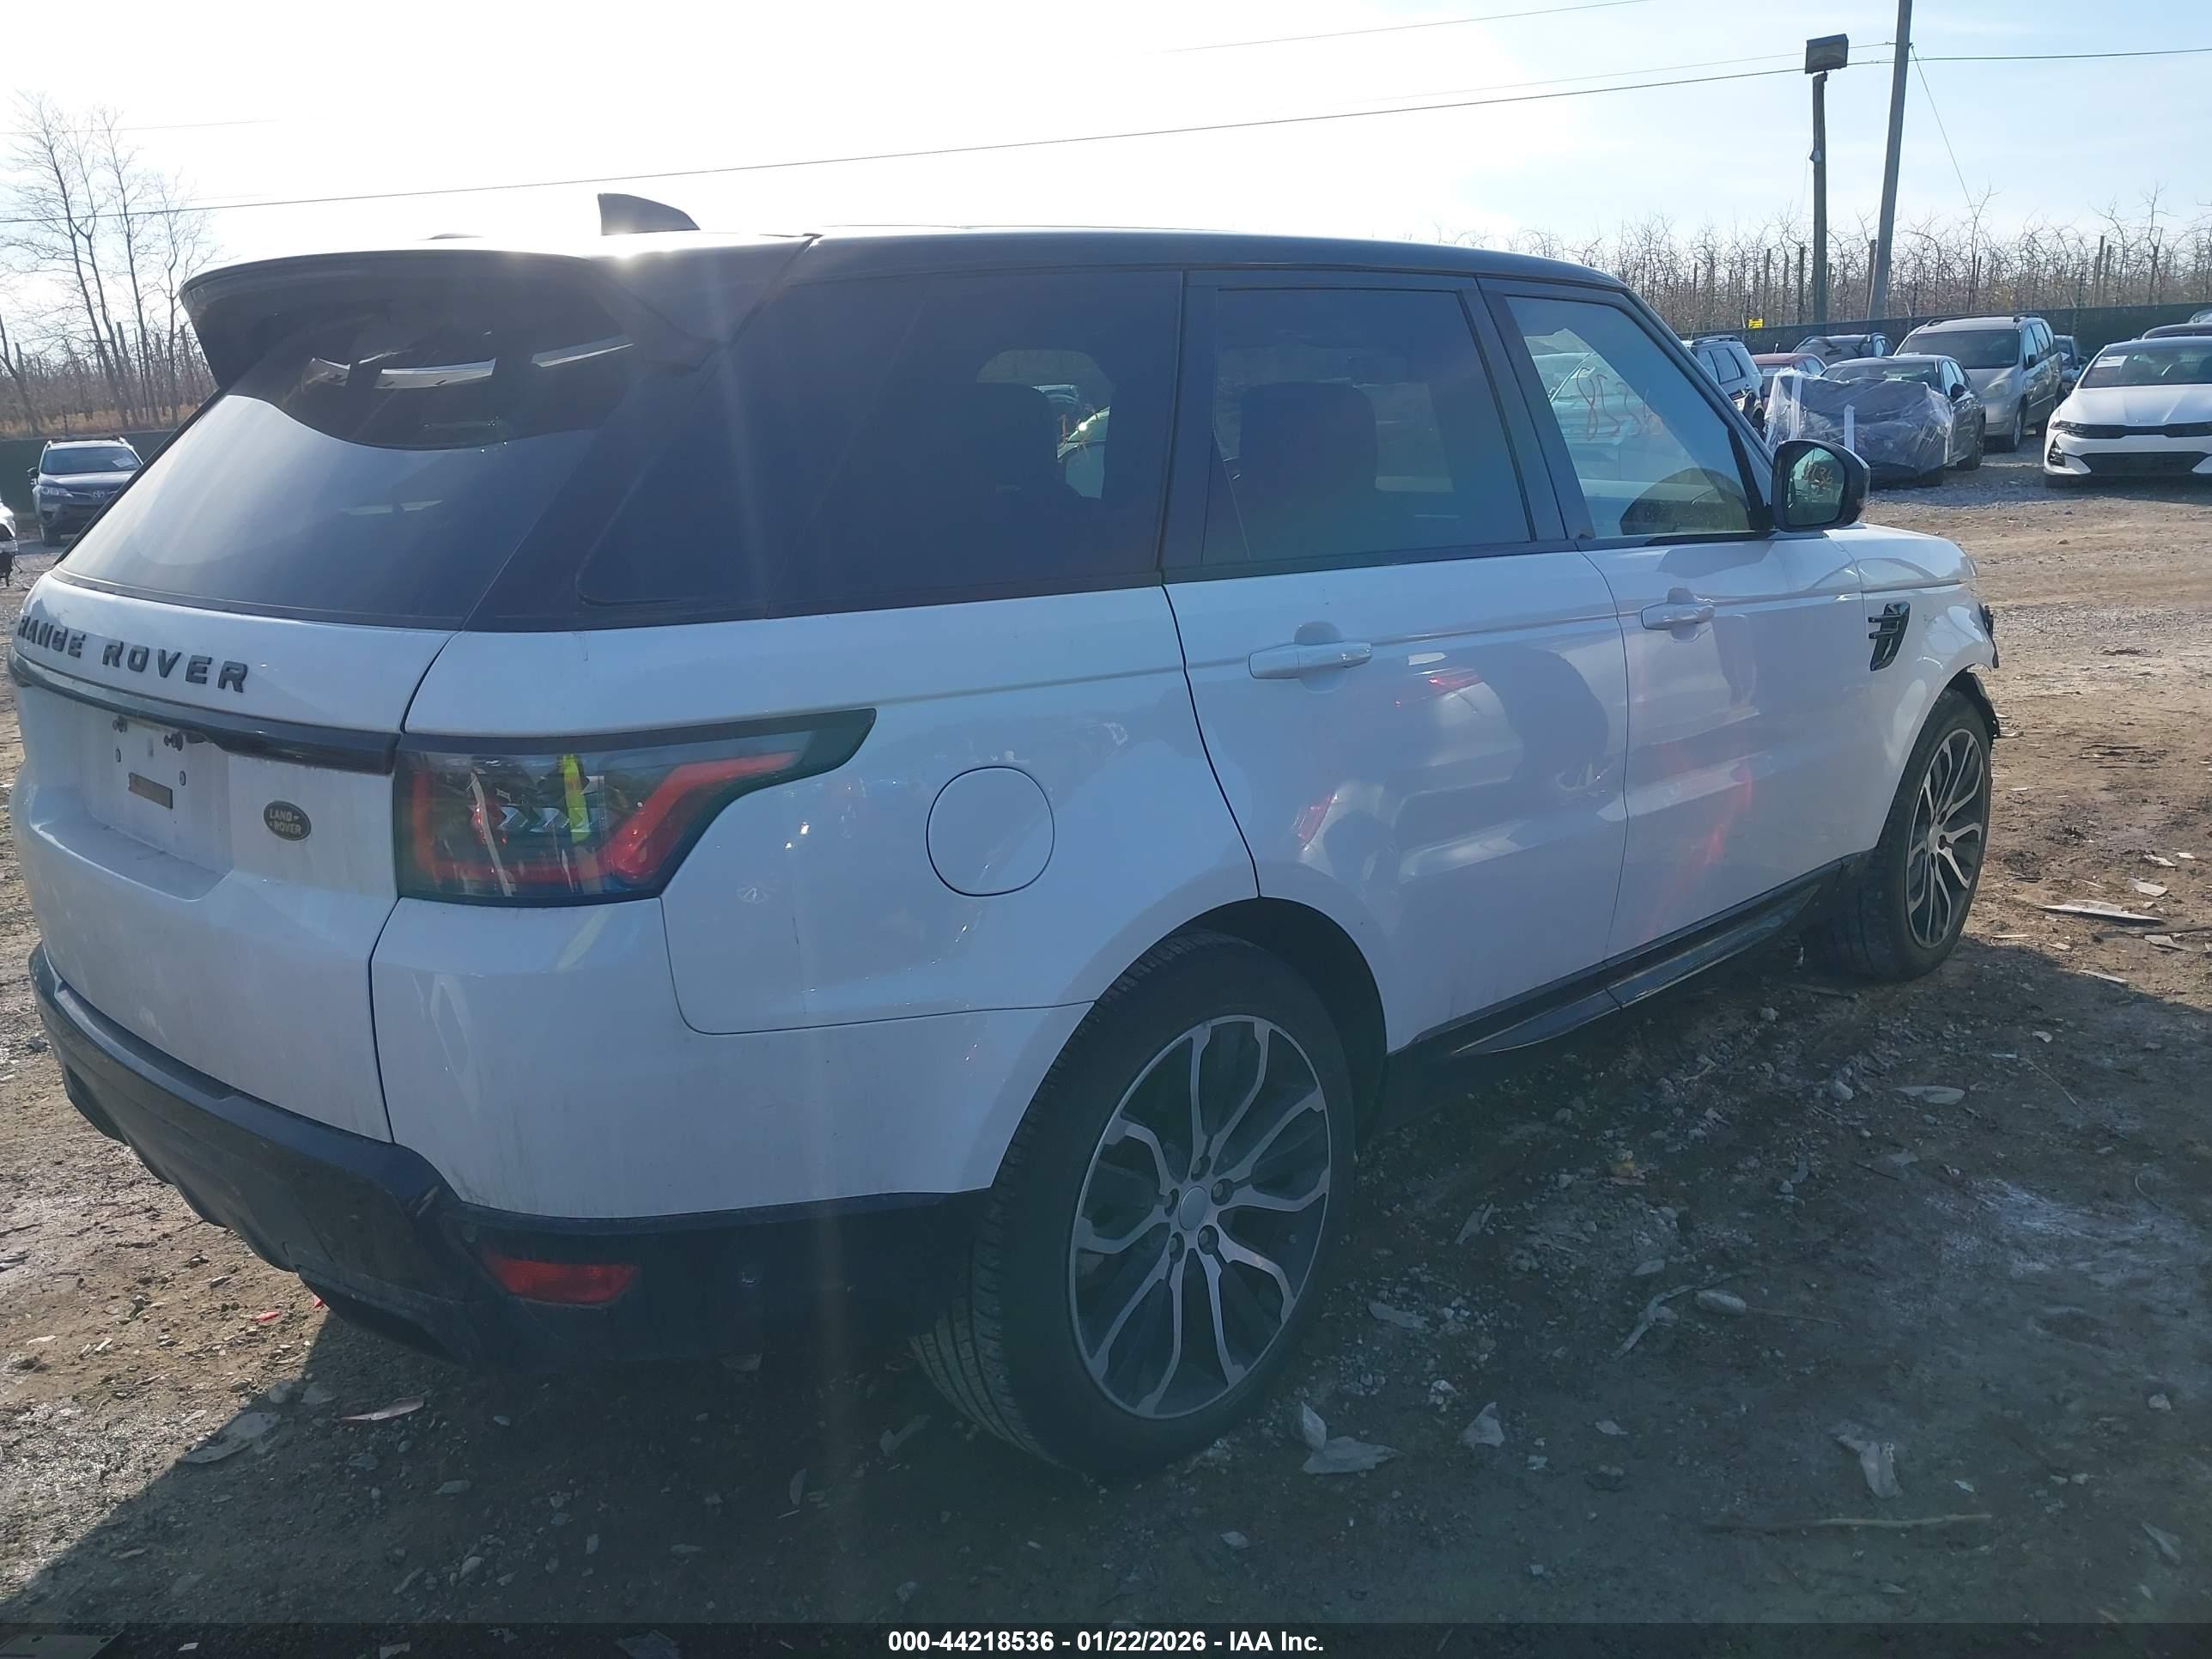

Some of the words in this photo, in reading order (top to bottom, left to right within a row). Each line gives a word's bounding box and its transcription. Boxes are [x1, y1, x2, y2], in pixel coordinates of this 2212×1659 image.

[16, 614, 87, 659] RANGE
[101, 641, 249, 694] ROVER
[274, 821, 302, 835] ROVER
